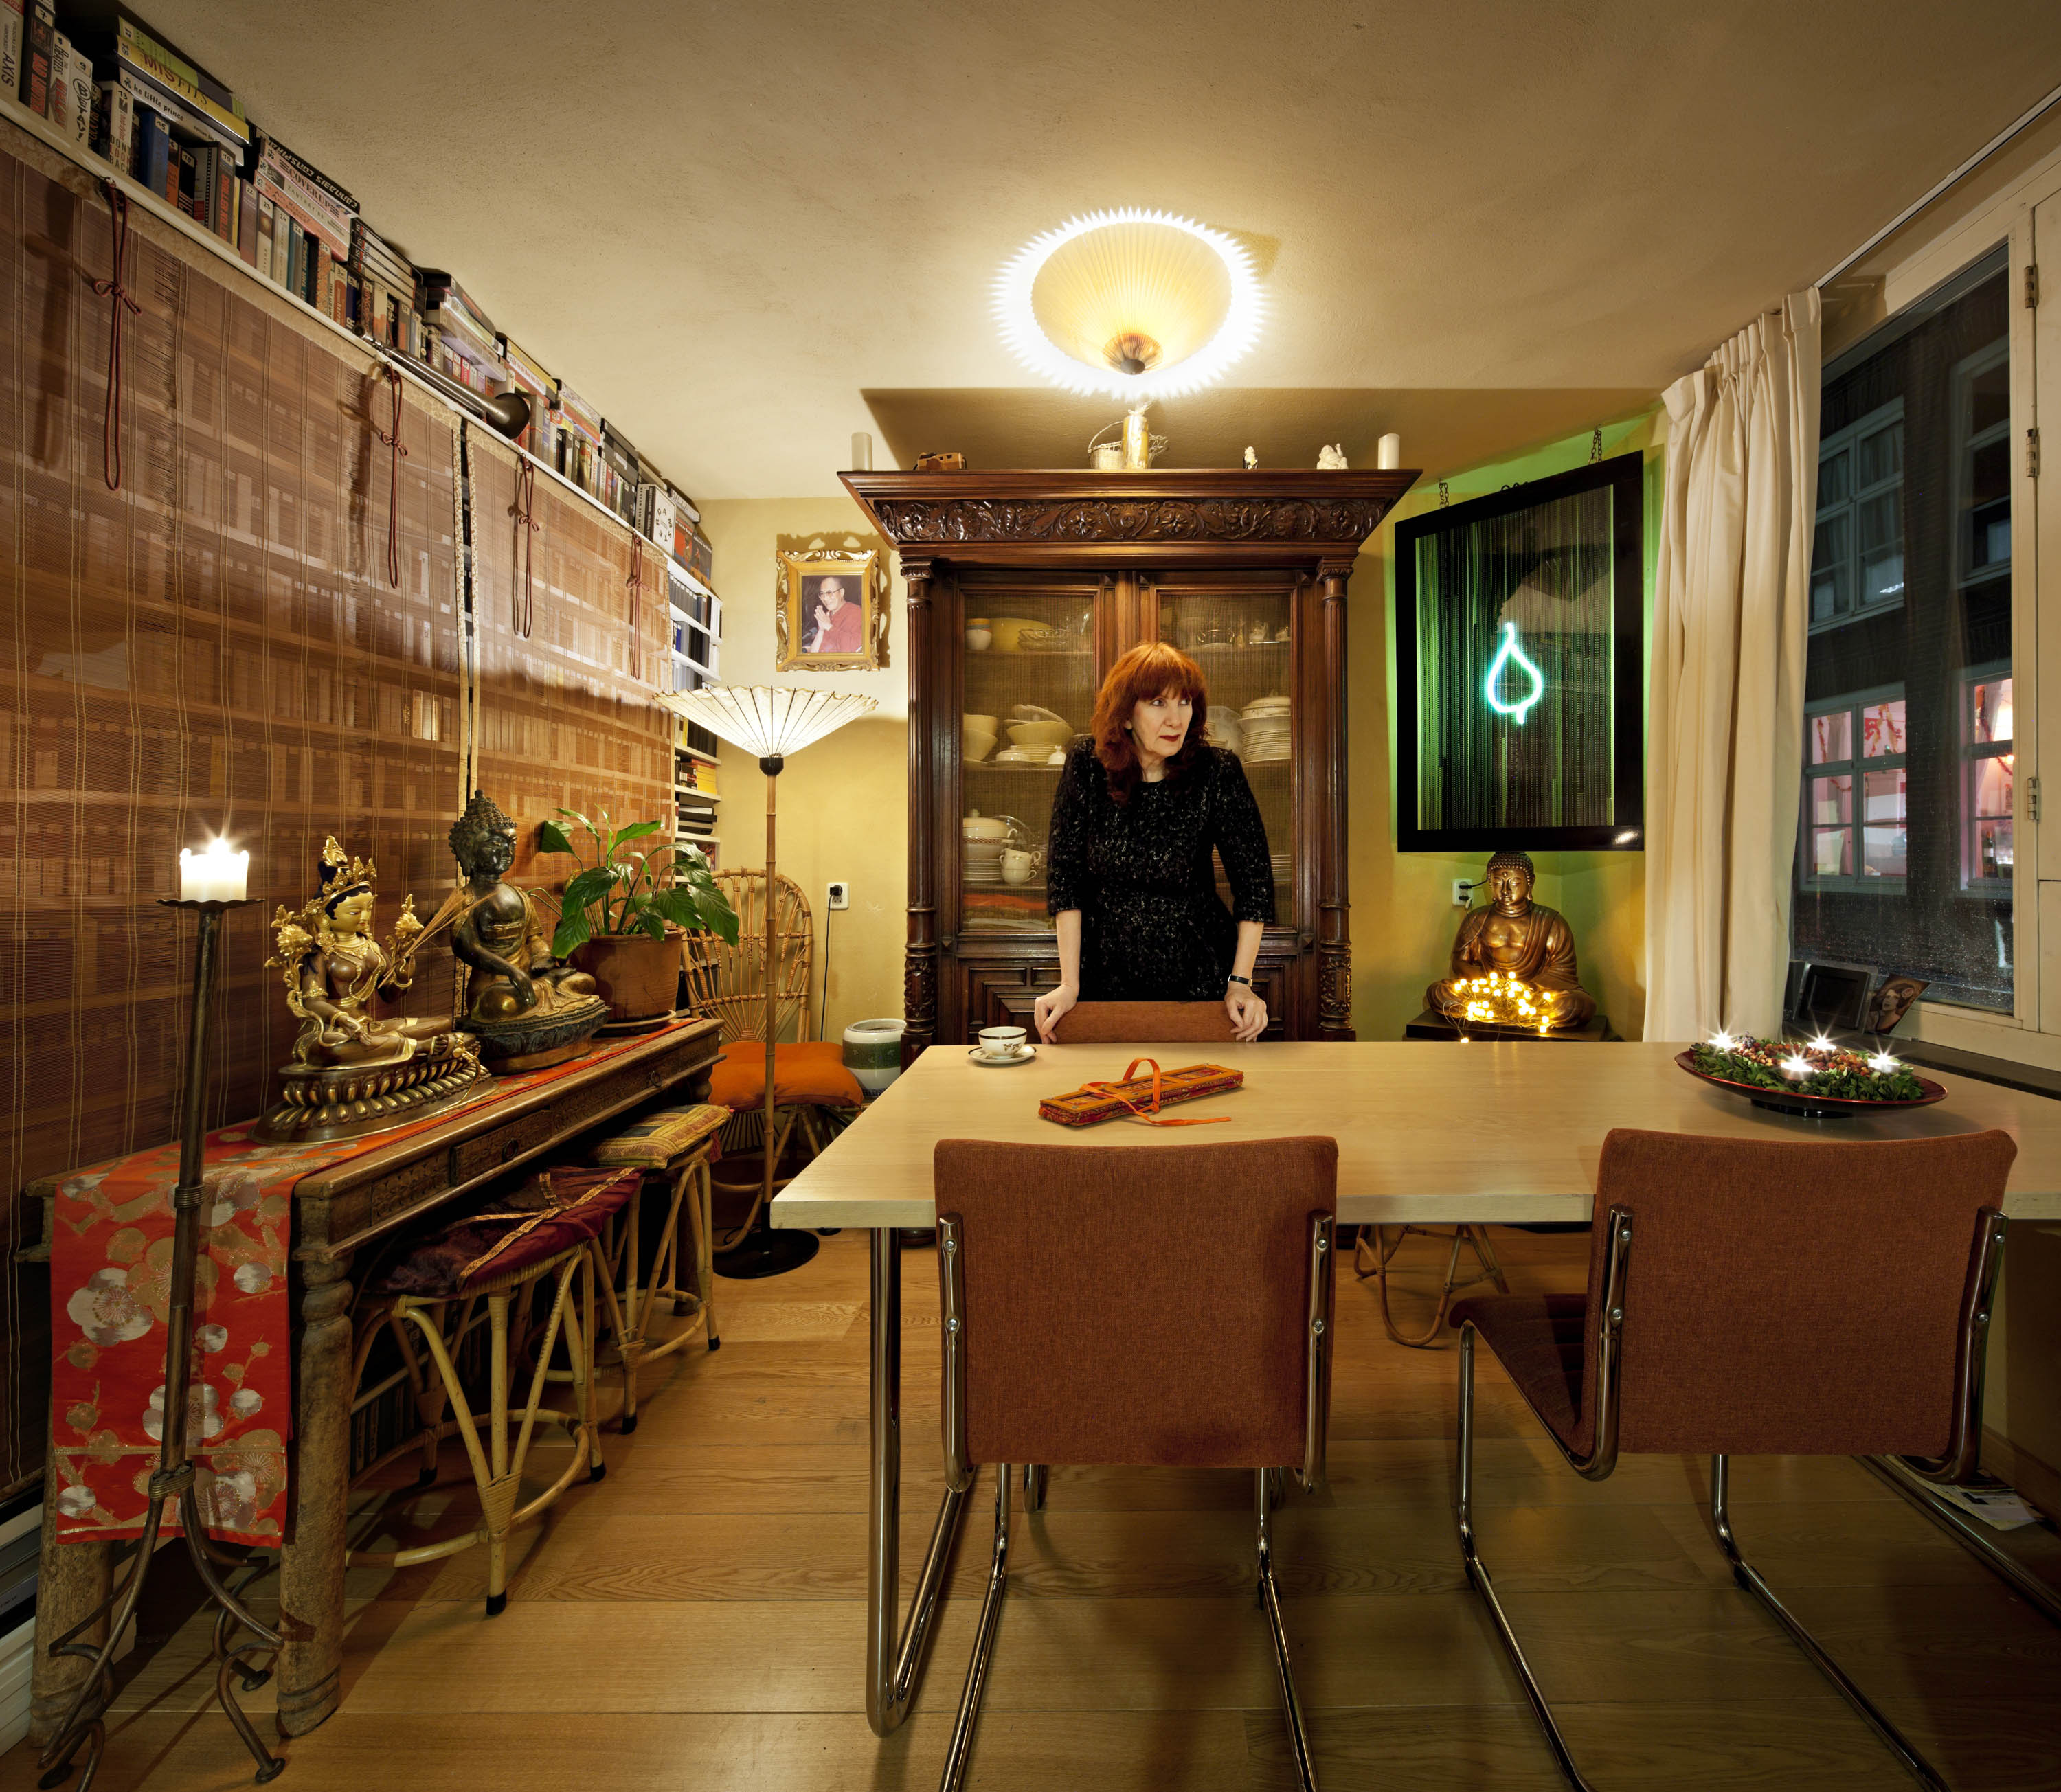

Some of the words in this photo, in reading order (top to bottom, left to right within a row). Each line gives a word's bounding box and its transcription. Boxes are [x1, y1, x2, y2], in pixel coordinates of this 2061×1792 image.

[1, 51, 15, 87] AXIS
[53, 44, 69, 76] BEATLES
[117, 91, 128, 100] 13
[133, 82, 142, 95] he
[144, 89, 161, 106] little
[164, 104, 184, 121] prince
[157, 122, 166, 131] 15
